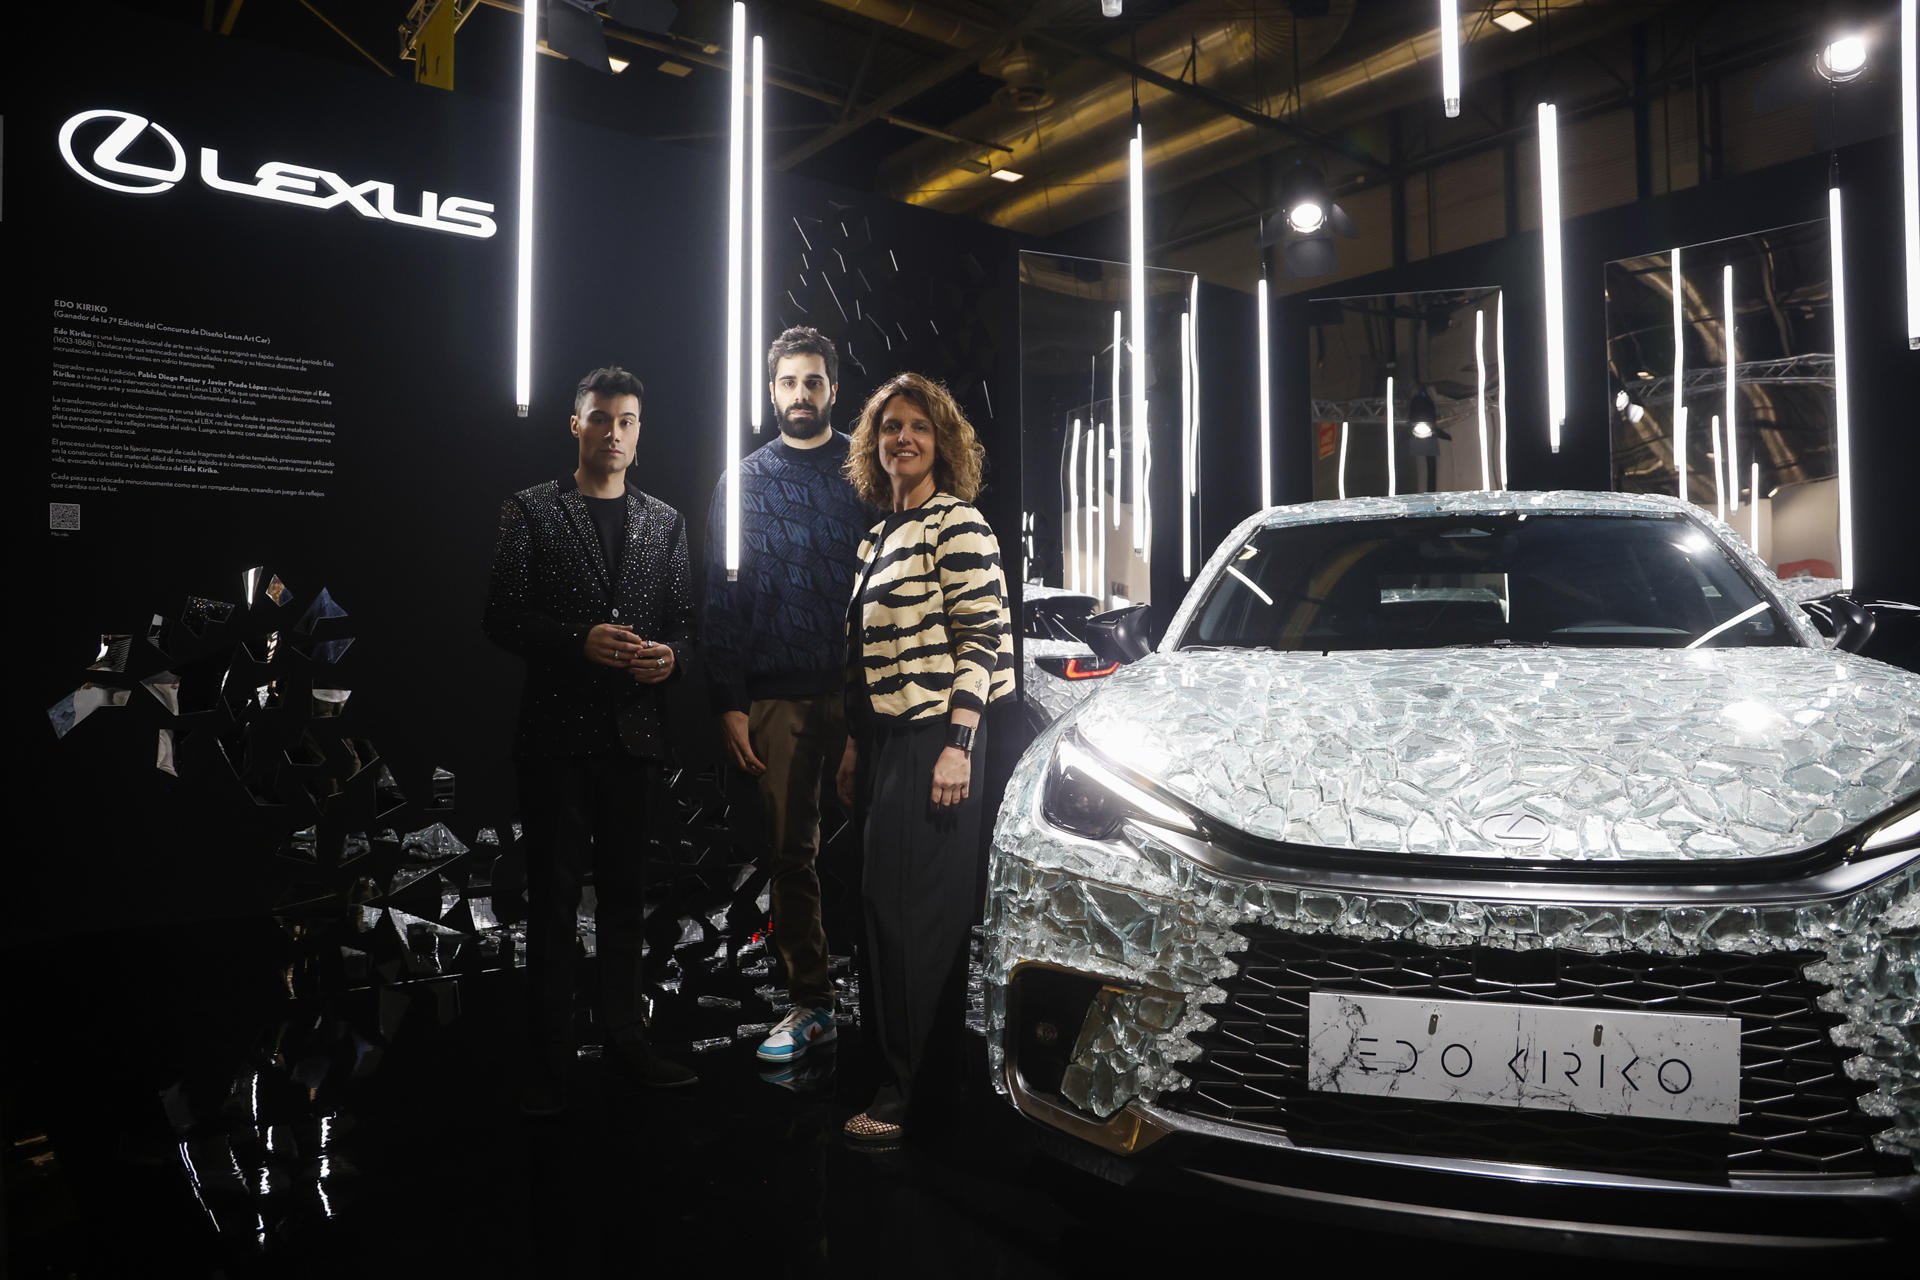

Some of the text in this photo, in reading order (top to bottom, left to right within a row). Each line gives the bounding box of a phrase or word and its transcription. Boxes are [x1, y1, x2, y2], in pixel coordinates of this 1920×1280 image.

[200, 147, 497, 239] LEXUS
[54, 300, 108, 313] EDO KIRIKO
[54, 310, 89, 321] (Ganador
[118, 318, 144, 328] Edición
[145, 321, 156, 329] del
[156, 323, 190, 334] Concurso
[200, 328, 223, 338] Diseño
[224, 331, 242, 340] Lexus
[243, 334, 254, 342] Art
[255, 335, 270, 345] Car)
[1359, 1038, 1692, 1094] EDO KIRIKO
